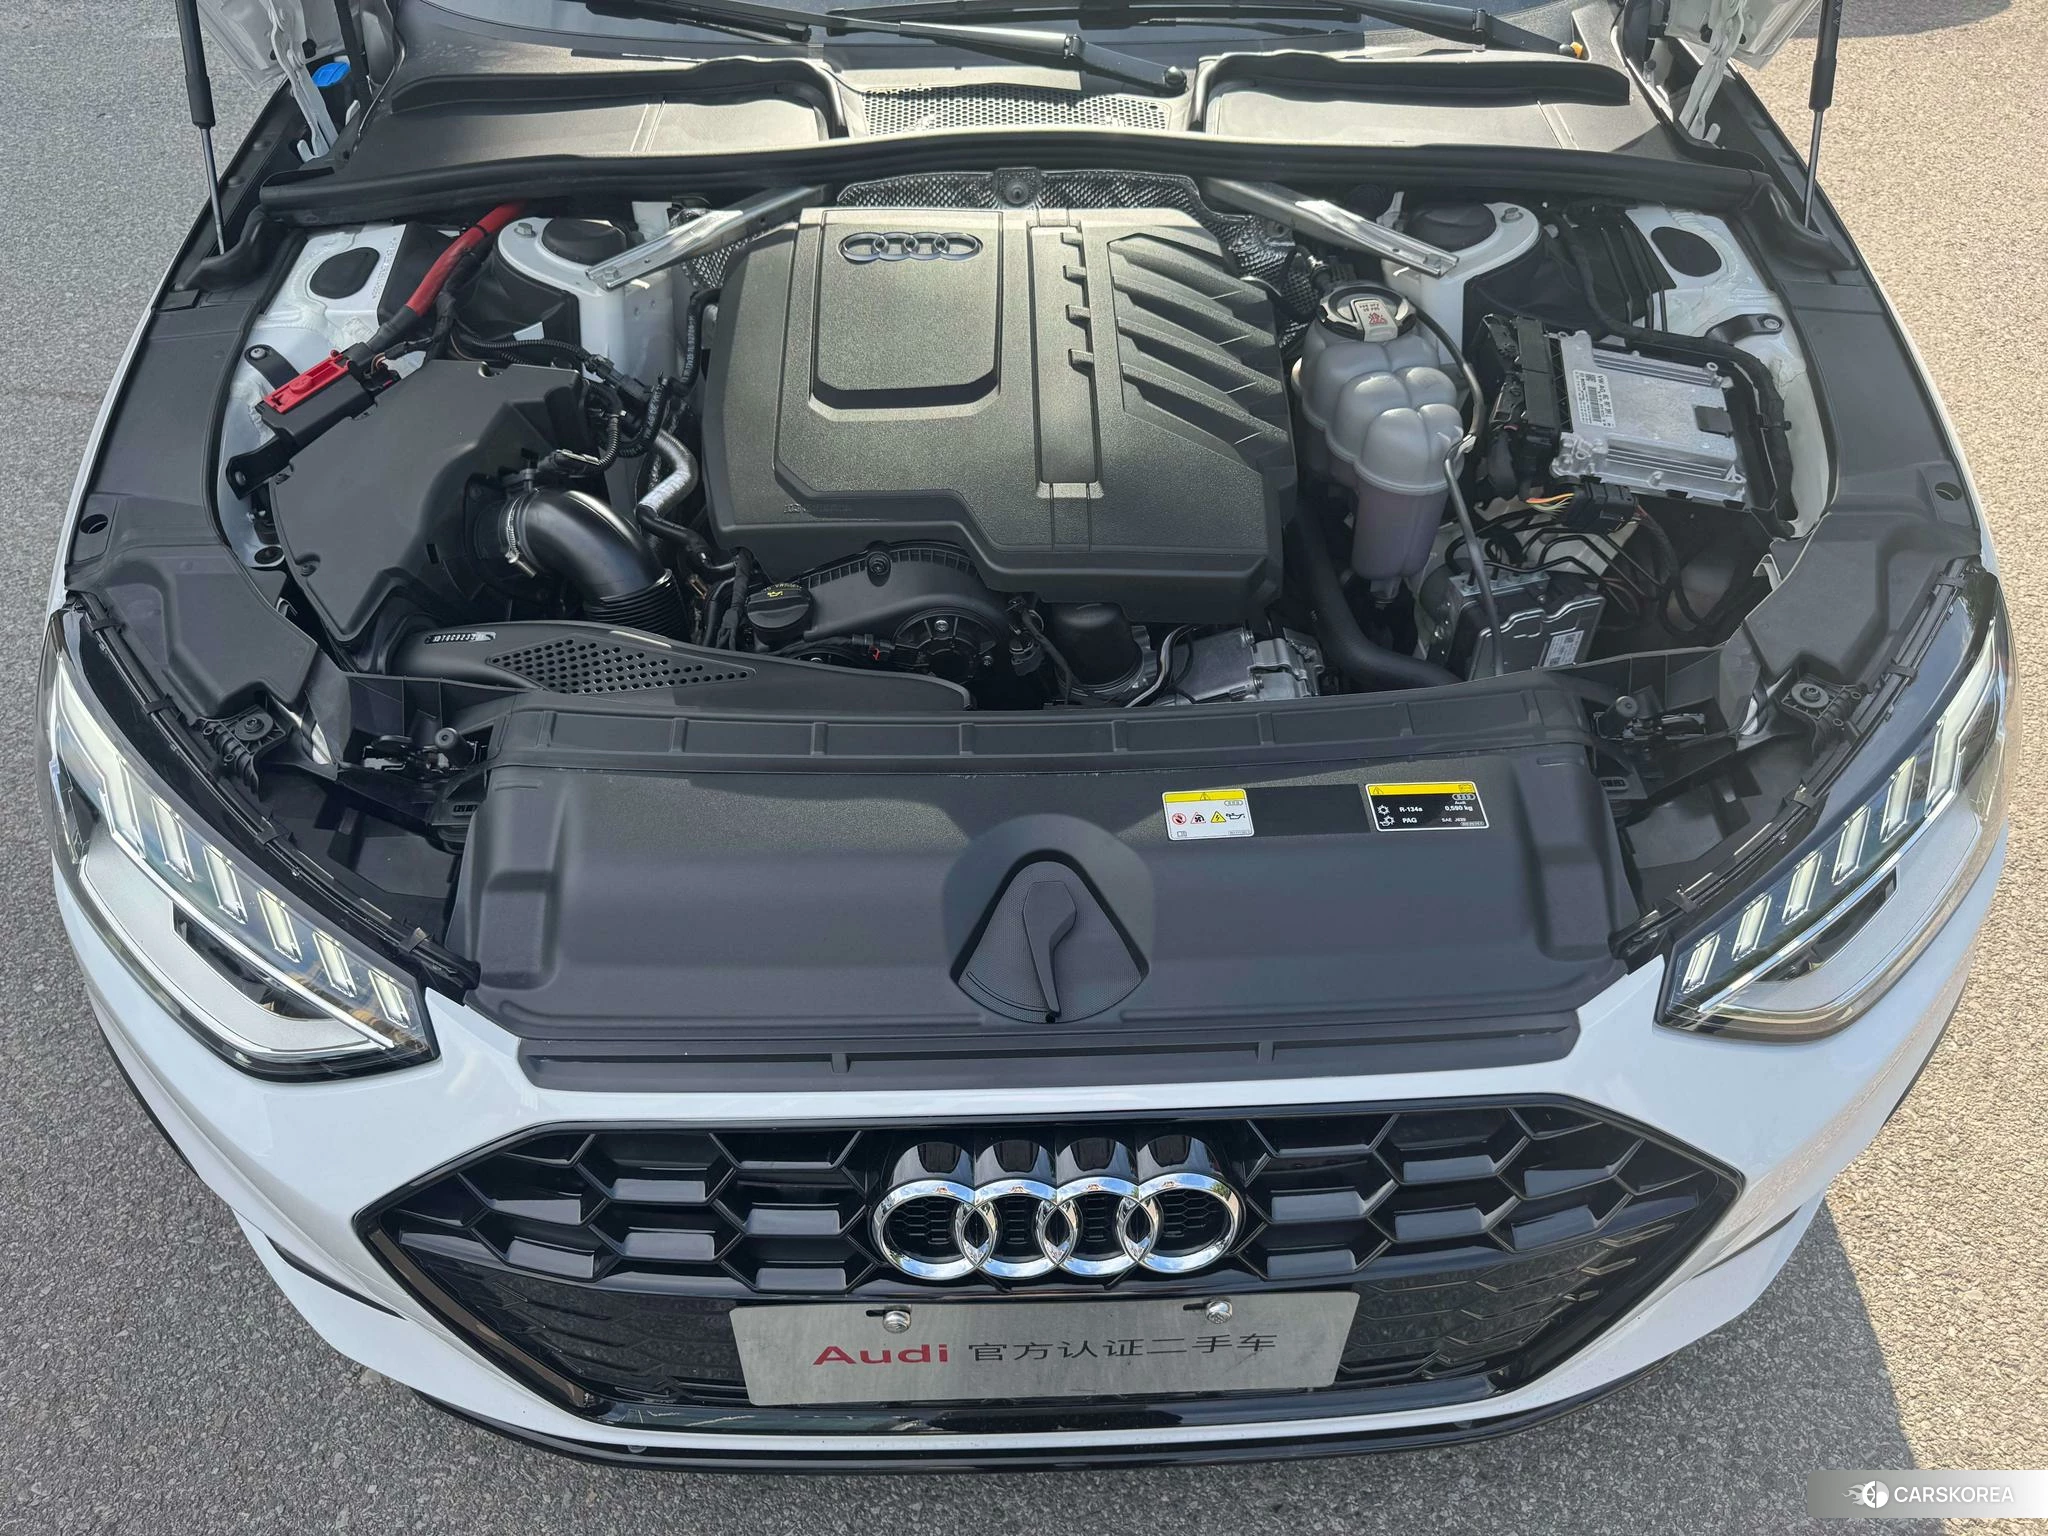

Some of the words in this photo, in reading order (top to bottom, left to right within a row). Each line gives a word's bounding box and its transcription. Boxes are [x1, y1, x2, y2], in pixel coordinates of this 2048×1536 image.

[812, 1343, 949, 1366] Audi
[968, 1334, 1277, 1361] 官方认证二手车
